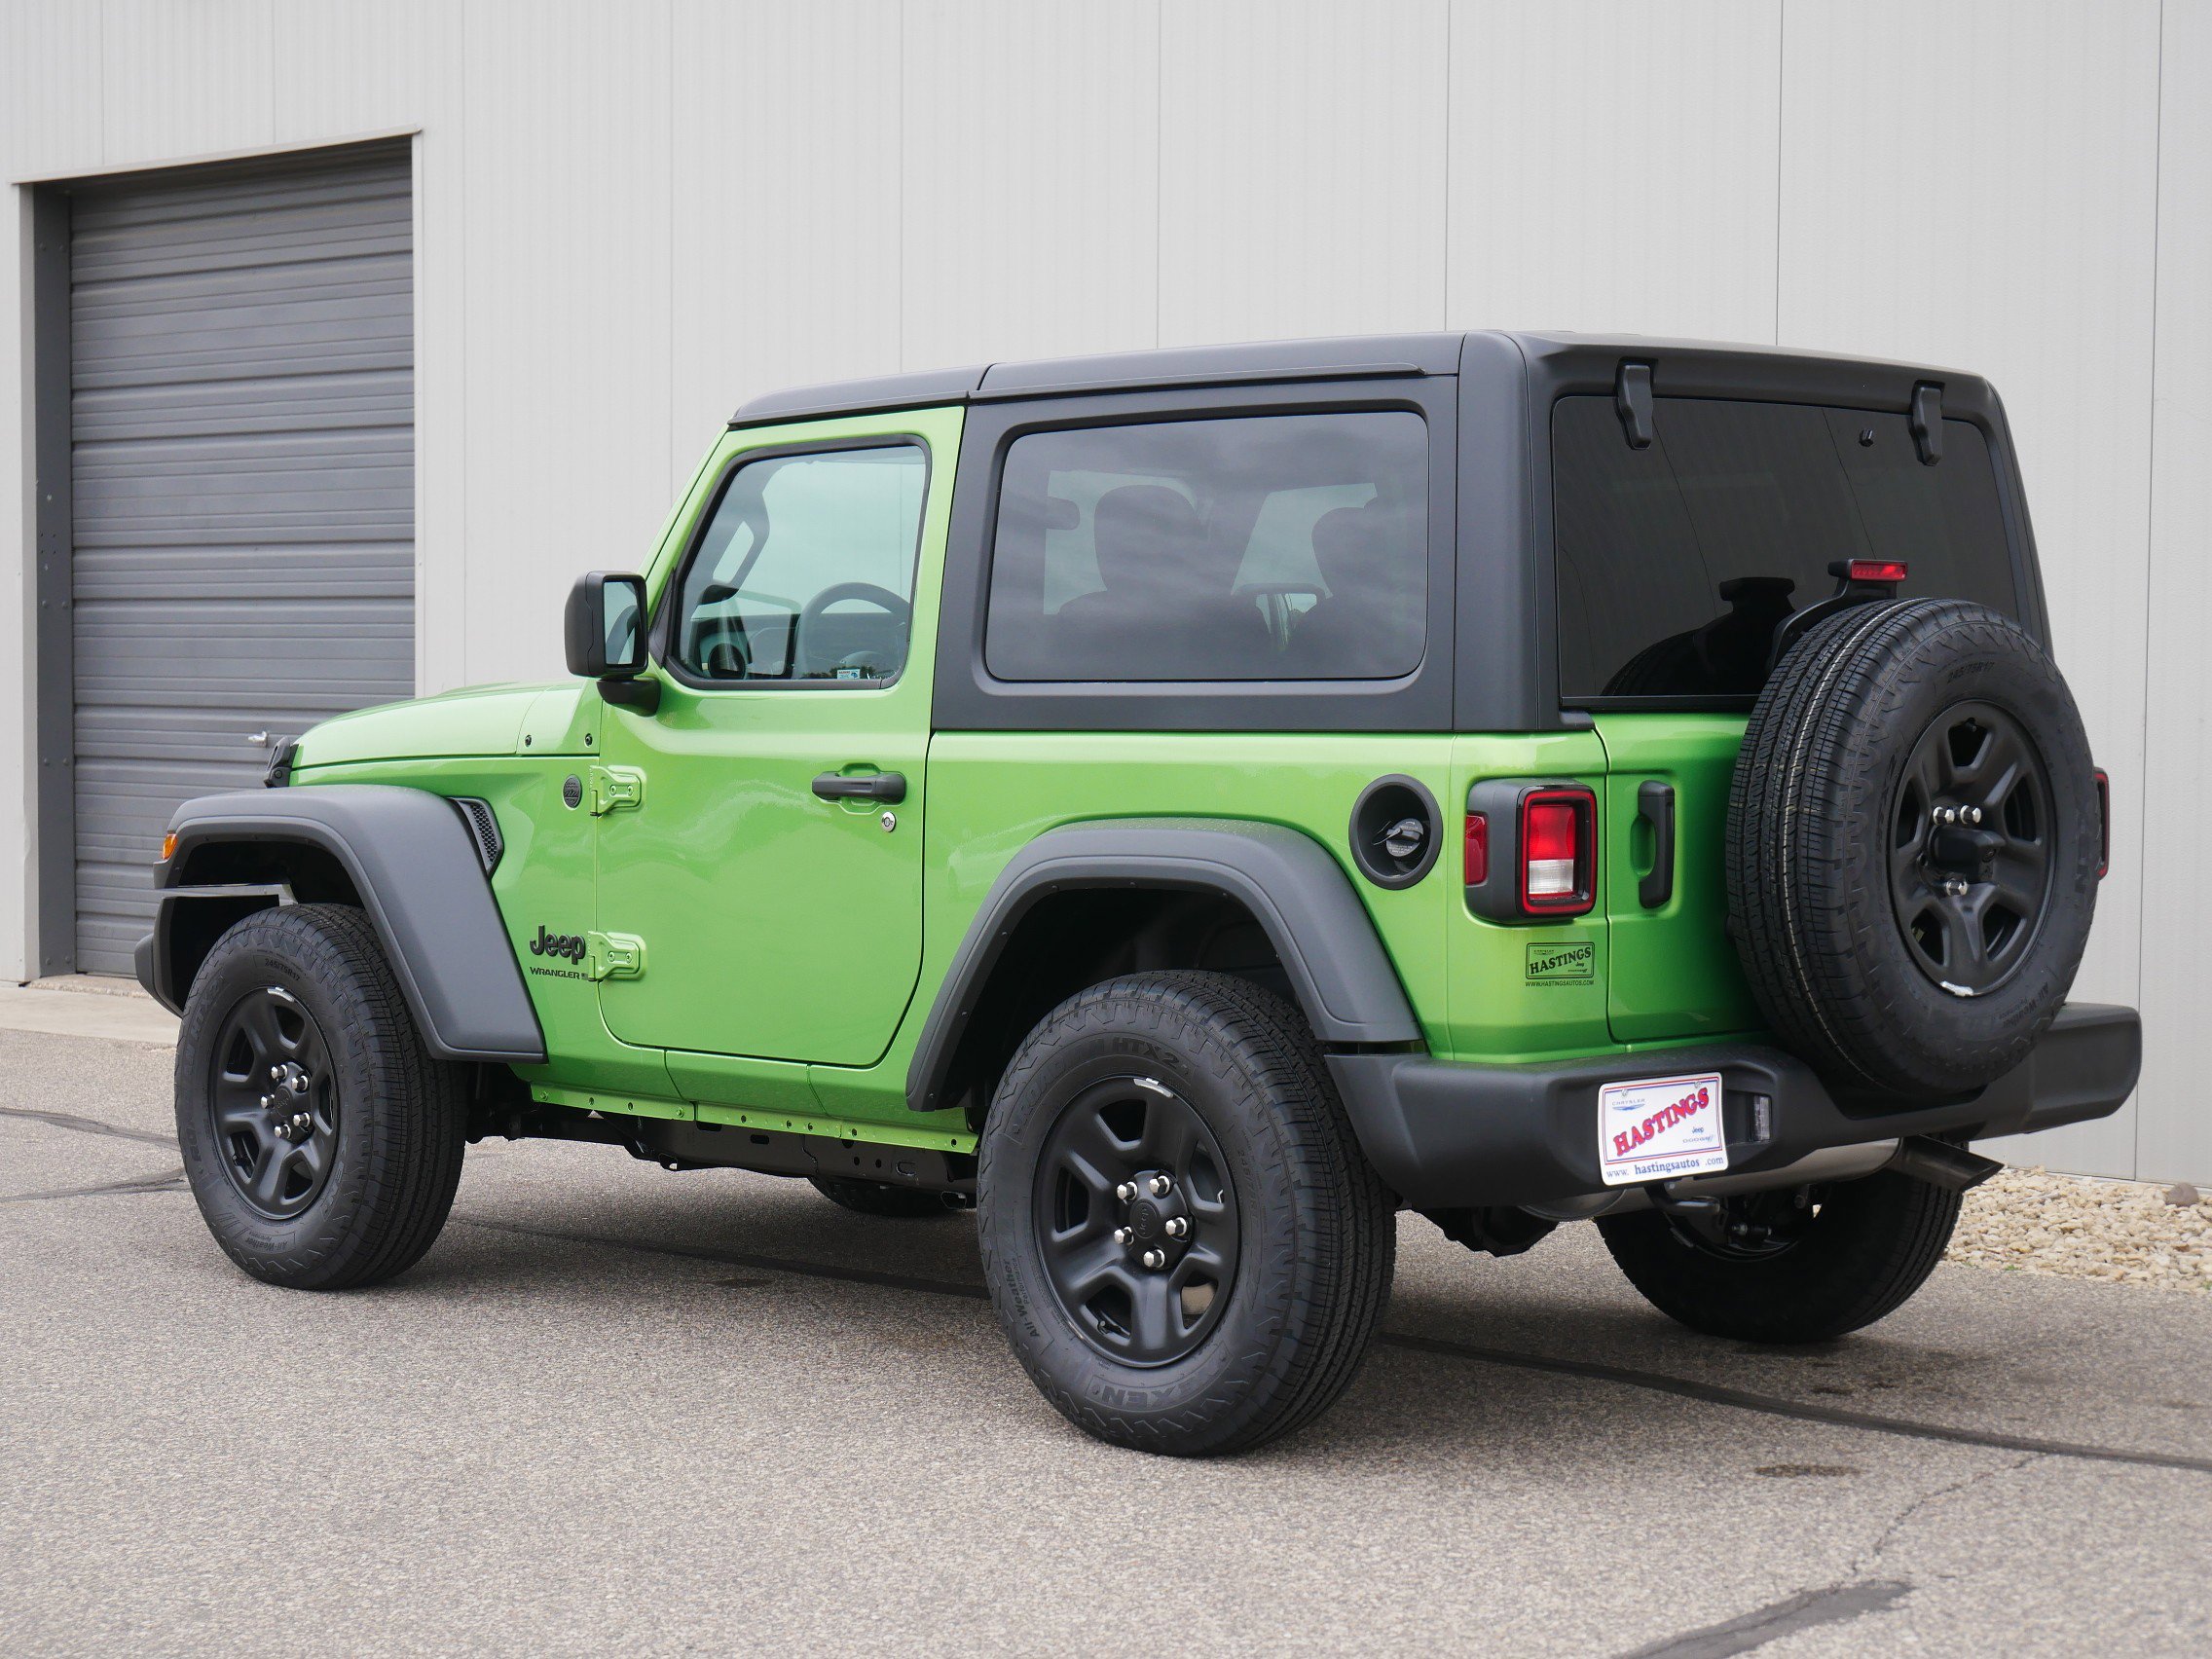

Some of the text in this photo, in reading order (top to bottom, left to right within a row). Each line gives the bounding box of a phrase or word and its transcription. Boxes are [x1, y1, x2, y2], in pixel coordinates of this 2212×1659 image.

[529, 925, 586, 965] Jeep
[265, 958, 301, 981] 245/75R17
[529, 967, 580, 979] WRANGLER
[1530, 946, 1592, 975] HASTINGS
[1113, 1038, 1180, 1069] HTX2
[1613, 1087, 1710, 1157] HASTINGS
[1606, 1156, 1724, 1178] www. hastingsautos .com
[1003, 1258, 1040, 1337] All-Weather
